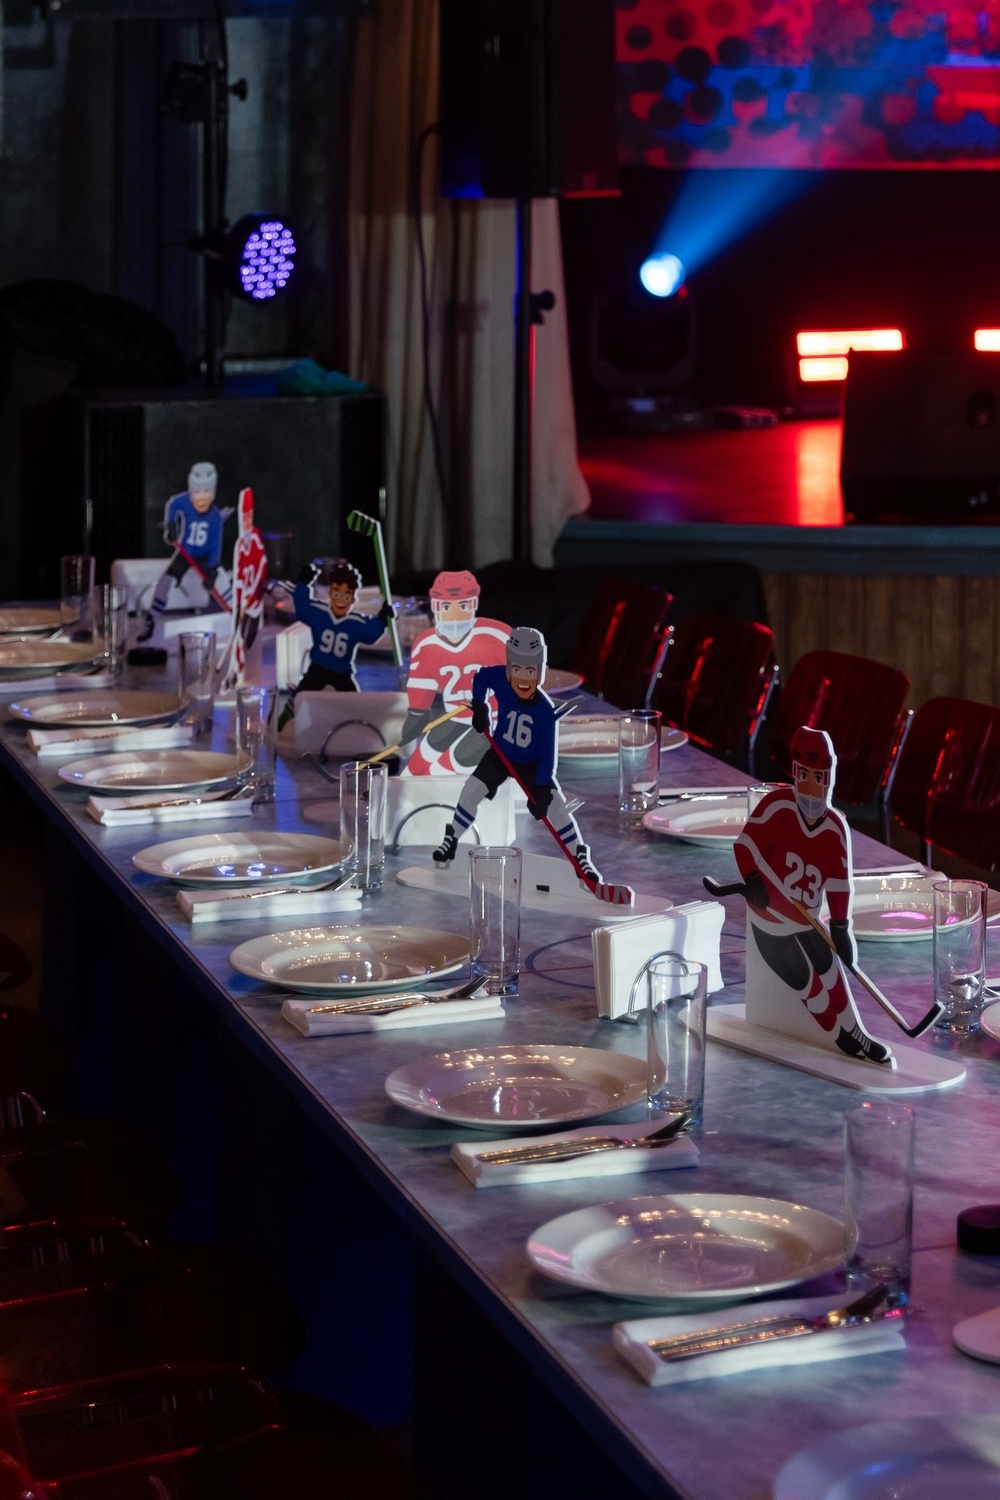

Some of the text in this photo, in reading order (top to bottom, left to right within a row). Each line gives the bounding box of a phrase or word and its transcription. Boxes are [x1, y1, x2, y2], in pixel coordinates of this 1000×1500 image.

[187, 522, 208, 547] 16
[319, 629, 348, 657] 96
[502, 711, 534, 748] 16
[783, 852, 822, 909] 23
